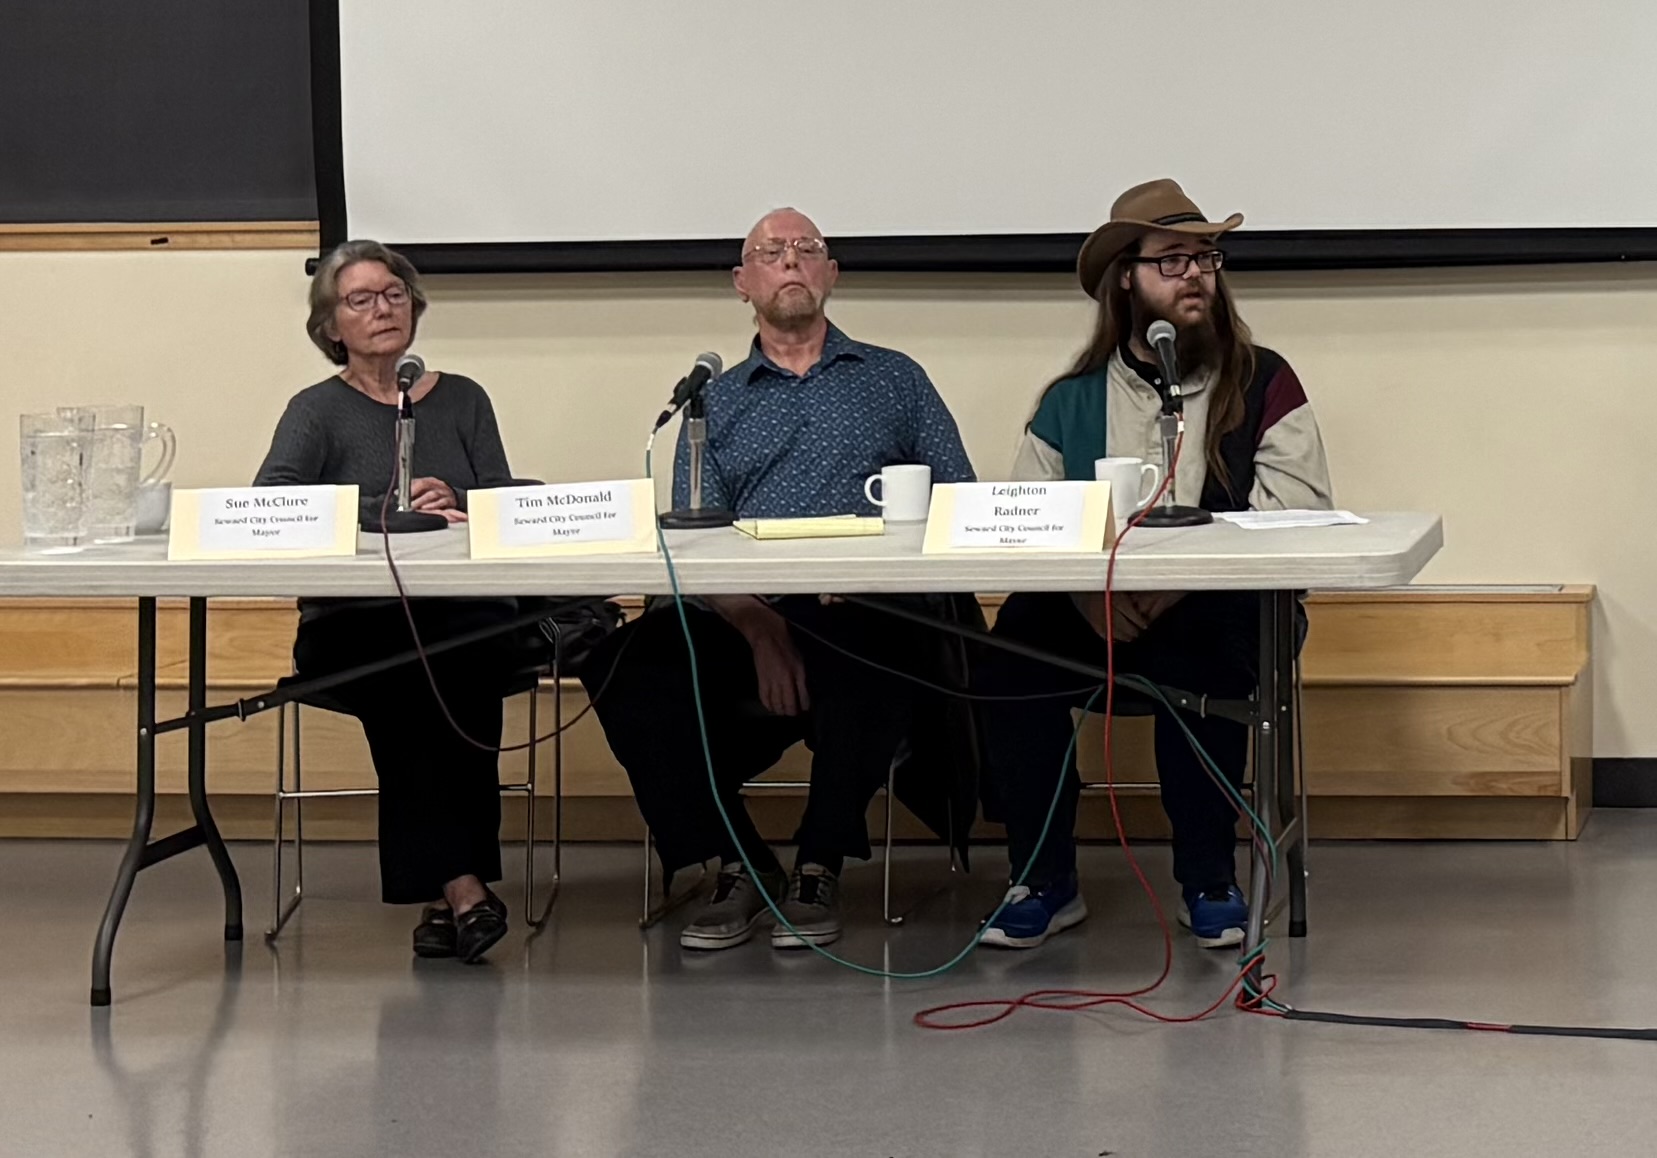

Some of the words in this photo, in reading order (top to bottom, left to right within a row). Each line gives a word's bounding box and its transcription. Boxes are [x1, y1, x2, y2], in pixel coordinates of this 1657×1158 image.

[991, 485, 1047, 498] Leighton
[225, 498, 250, 509] Sue
[253, 496, 309, 508] McClure
[515, 497, 543, 508] Tim
[547, 490, 612, 506] McDonald
[994, 505, 1041, 516] Radner
[249, 515, 267, 525] City
[270, 514, 303, 524] Council
[549, 514, 566, 525] City
[569, 512, 602, 522] Council
[999, 524, 1015, 533] City
[1017, 523, 1050, 532] Council
[1051, 523, 1064, 532] for
